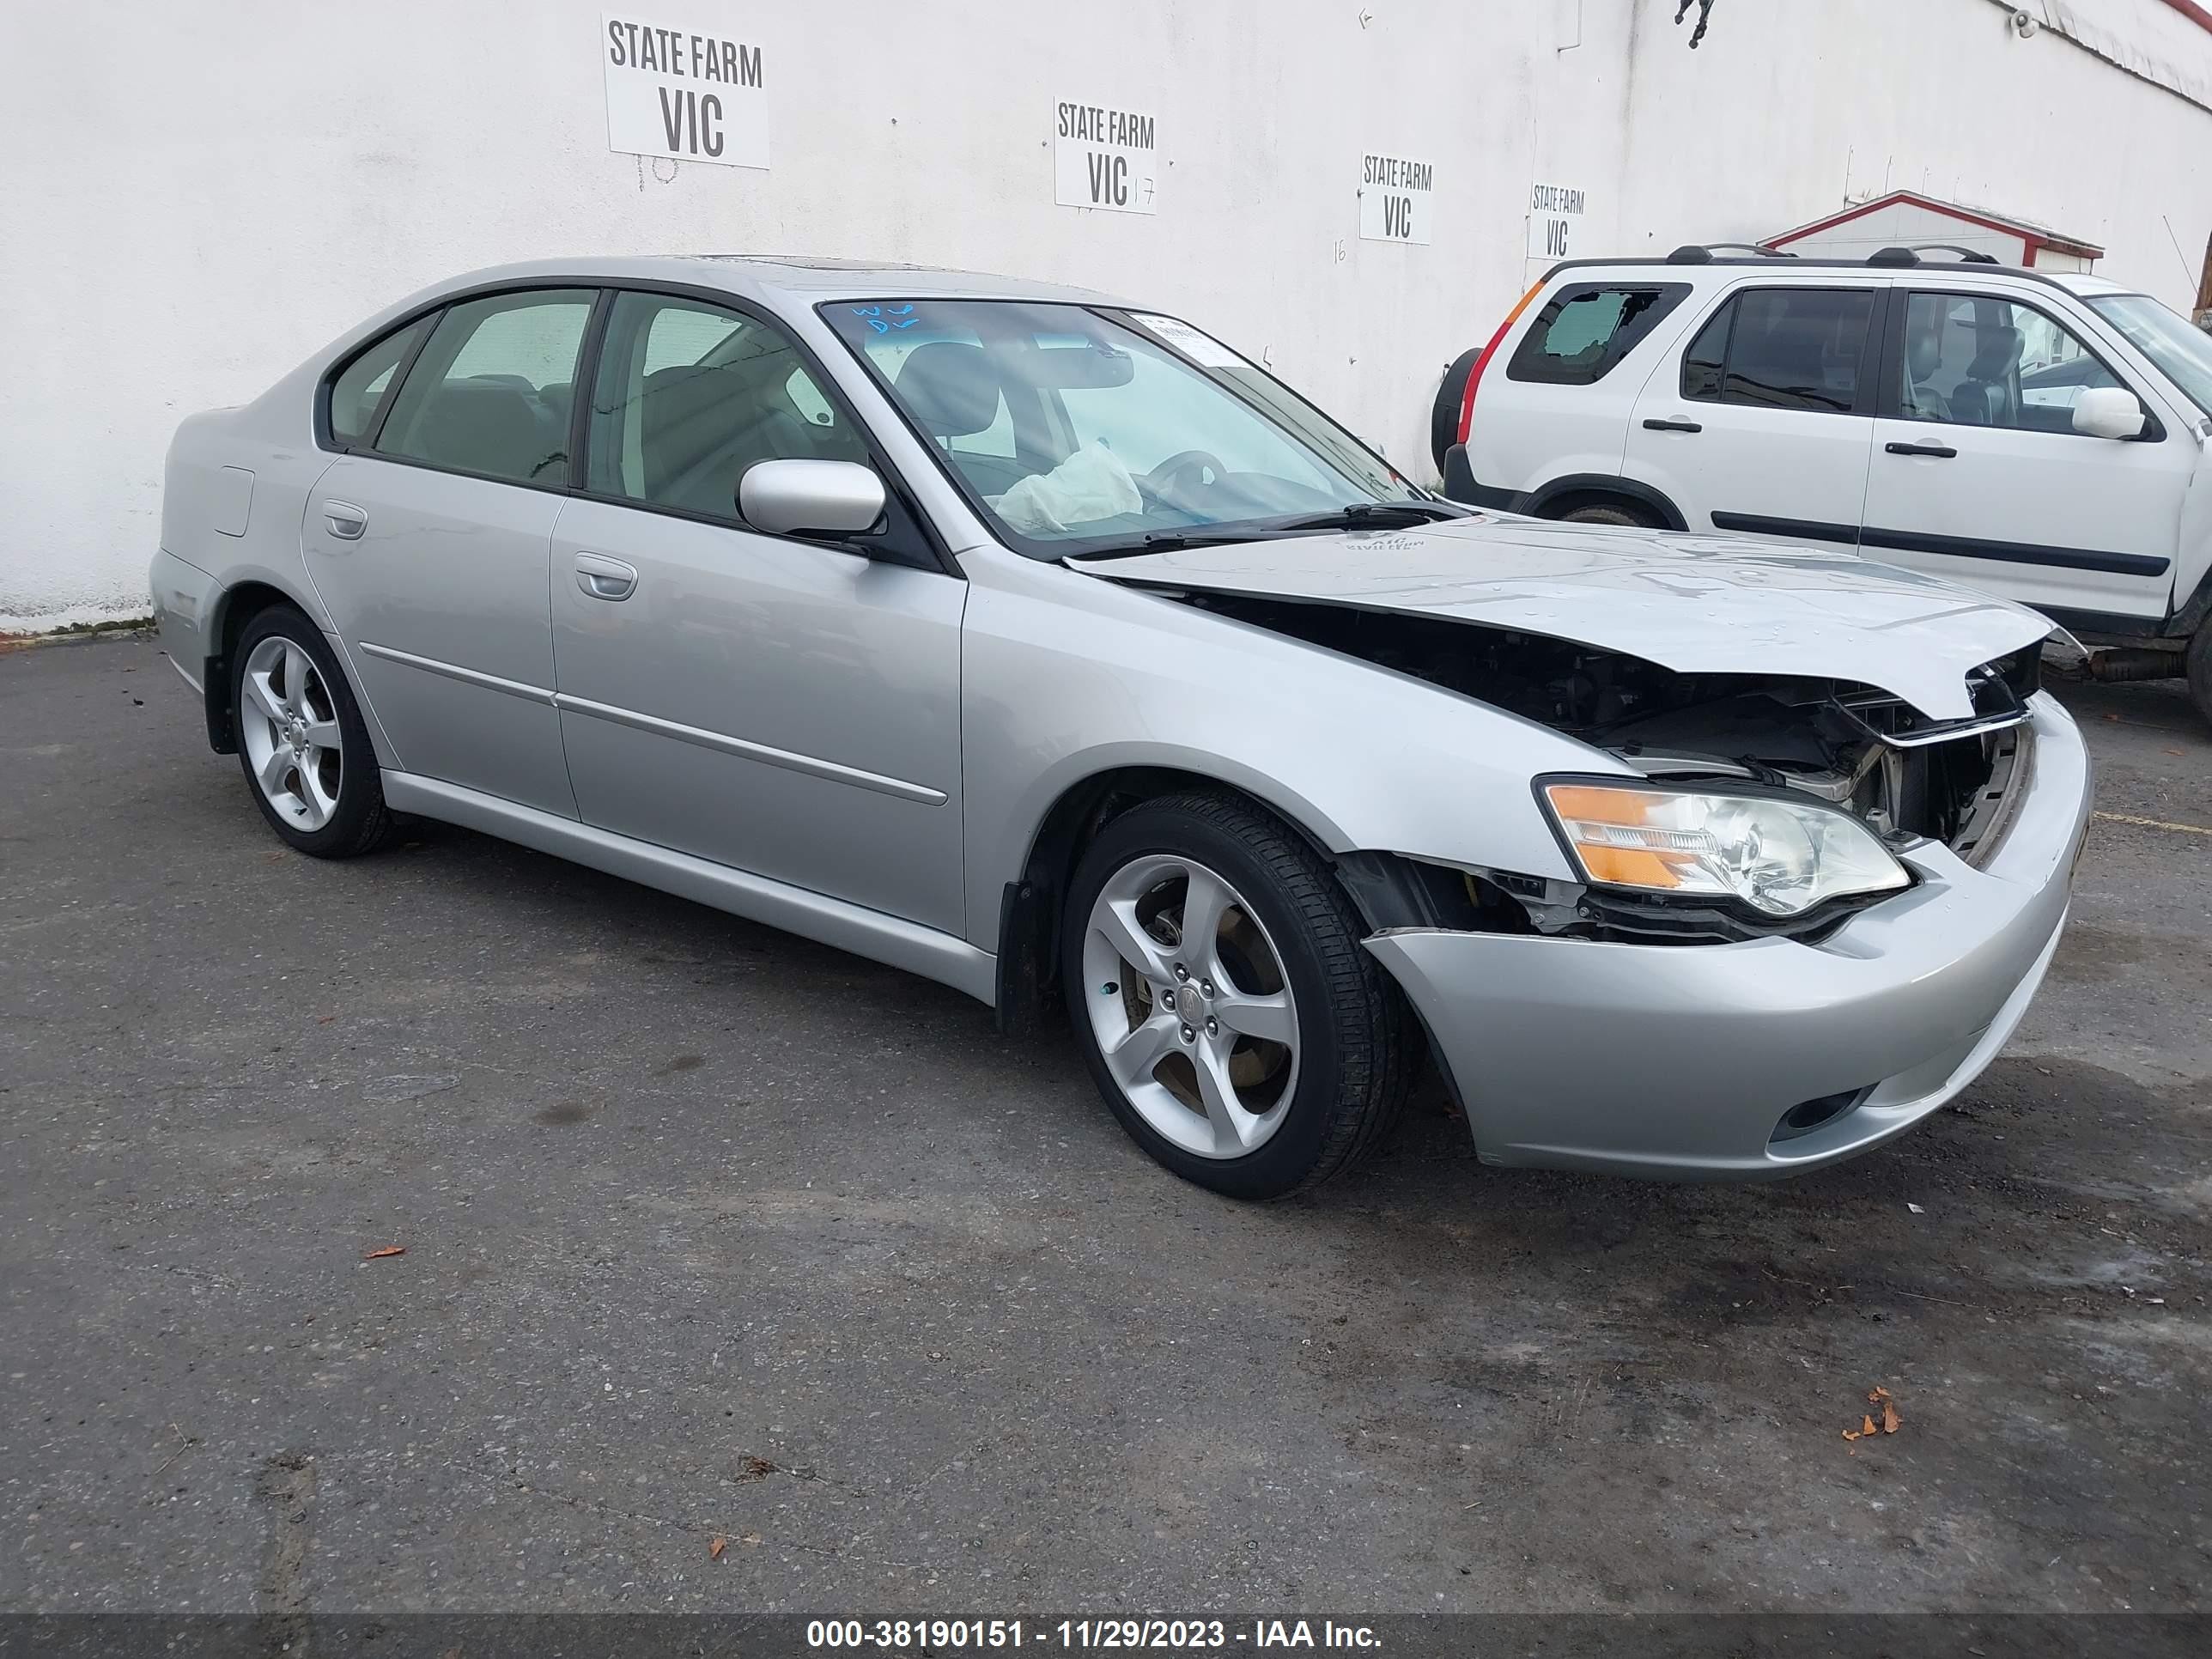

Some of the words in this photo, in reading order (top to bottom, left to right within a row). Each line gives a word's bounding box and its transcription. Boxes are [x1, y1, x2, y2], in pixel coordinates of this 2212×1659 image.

[608, 20, 685, 76] STATE
[690, 35, 763, 88] FARM
[659, 86, 724, 158] VIC
[1058, 102, 1104, 143] STATE
[1109, 110, 1154, 150] FARM
[1087, 152, 1127, 206] VIC
[1134, 178, 1155, 204] 17
[1364, 155, 1398, 187] STATE
[1400, 160, 1432, 191] FARM
[1383, 194, 1412, 239] VIC
[1533, 185, 1558, 212] STATE
[1559, 188, 1585, 215] FARM
[1547, 219, 1568, 257] VIC
